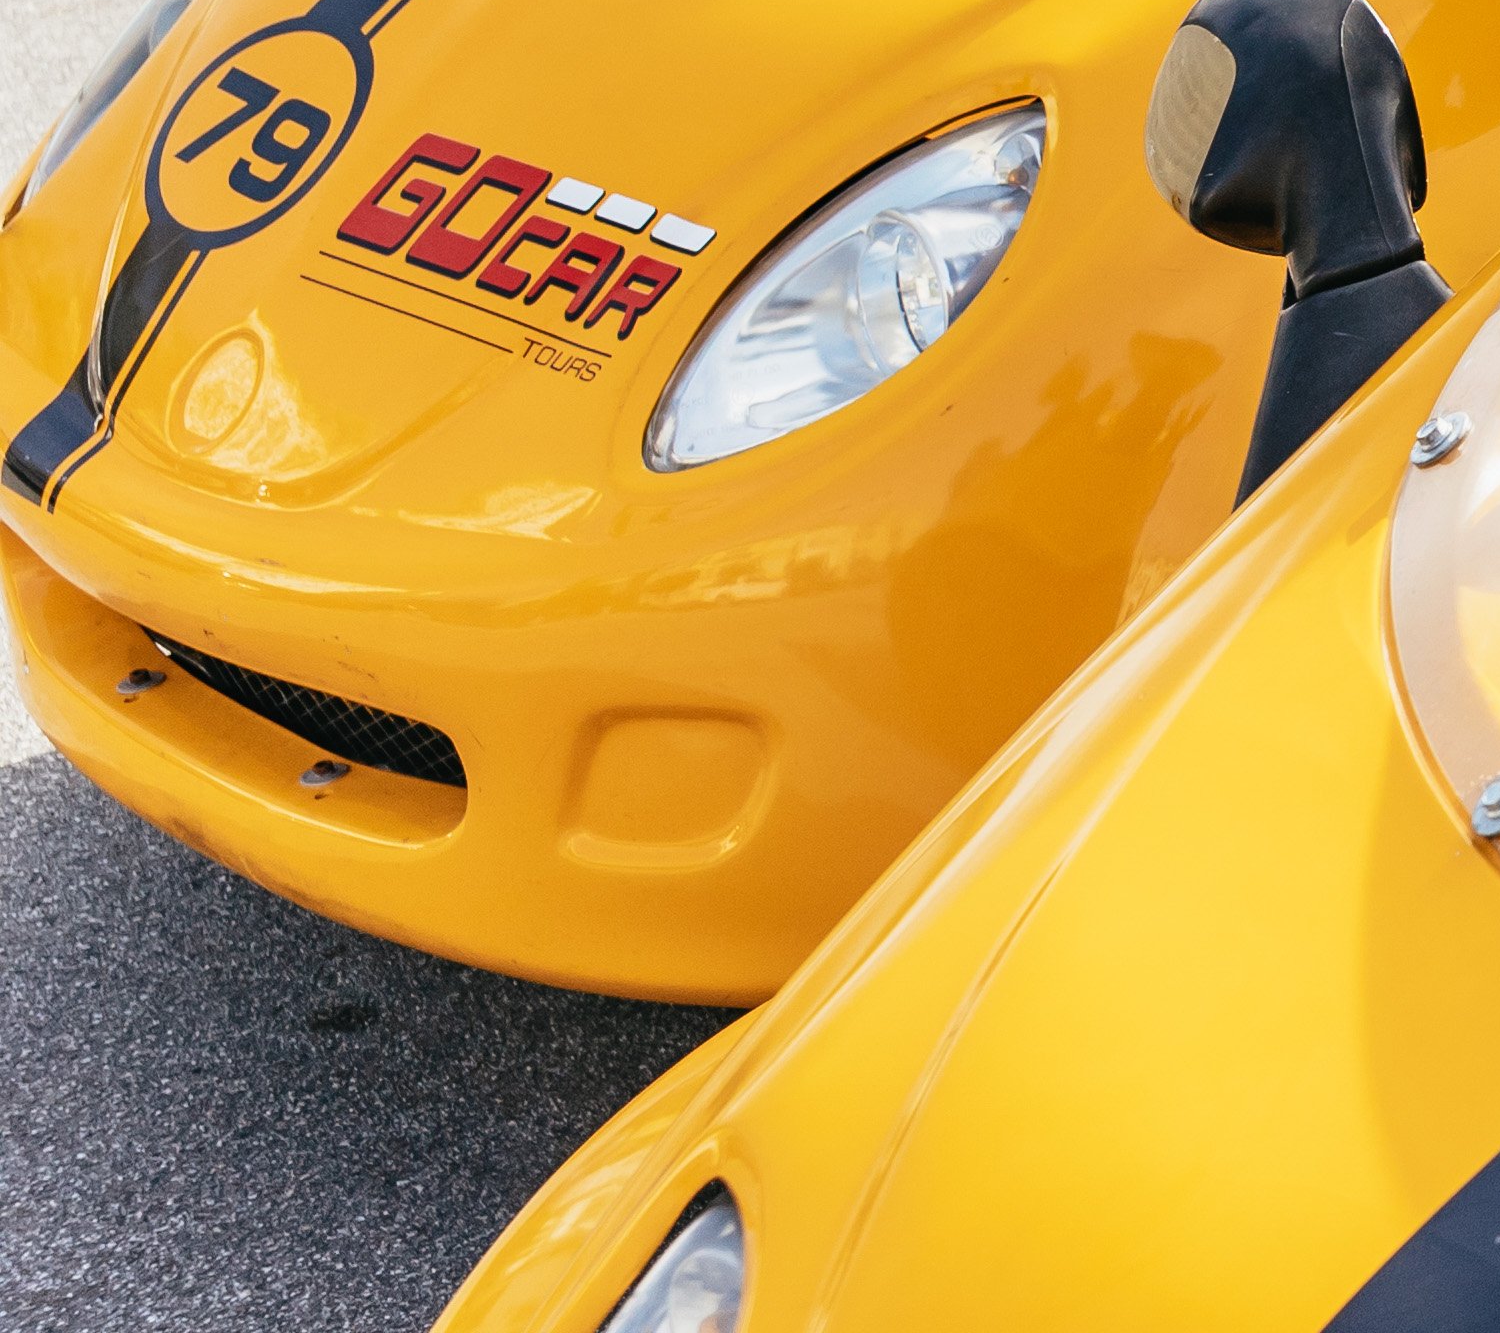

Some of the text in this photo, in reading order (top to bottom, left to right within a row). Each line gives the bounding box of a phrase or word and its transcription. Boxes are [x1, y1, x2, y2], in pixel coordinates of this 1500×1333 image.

[174, 65, 332, 203] 79
[336, 132, 683, 342] GOCAR
[521, 337, 602, 384] TOURS
